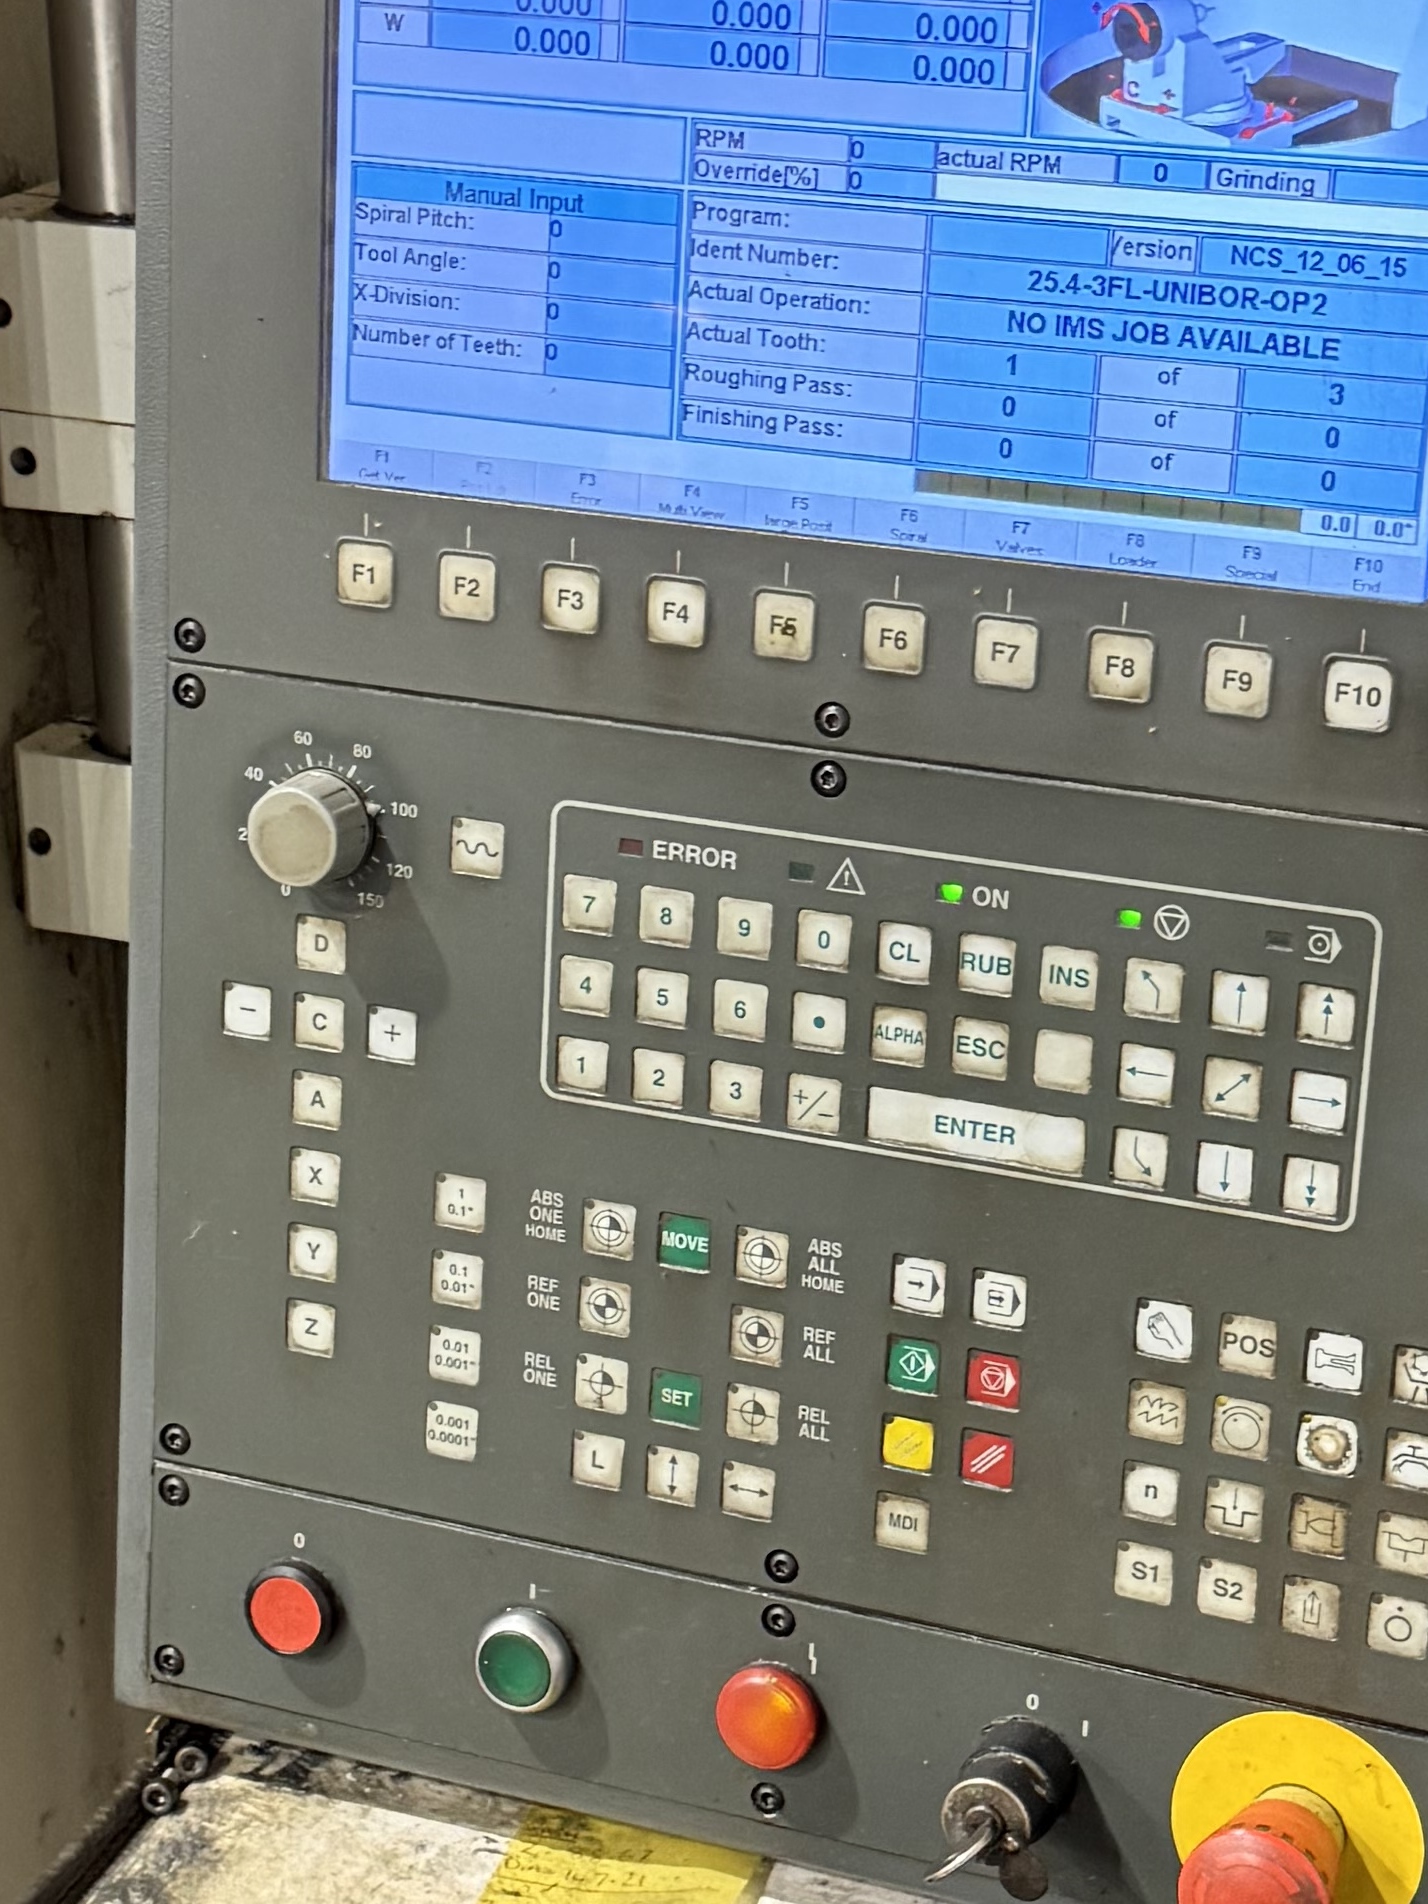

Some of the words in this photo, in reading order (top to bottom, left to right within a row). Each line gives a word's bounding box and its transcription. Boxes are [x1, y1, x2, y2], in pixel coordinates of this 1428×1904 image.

[712, 0, 792, 31] 0.000
[916, 12, 998, 45] 0.000
[384, 13, 406, 32] W
[514, 26, 591, 57] 0.000
[710, 40, 789, 71] 0.000
[913, 54, 995, 86] 0.000
[695, 128, 746, 150] RPM
[937, 149, 1004, 171] actual
[1009, 153, 1062, 176] RPM
[1154, 163, 1169, 184] 0
[1216, 167, 1317, 198] Grinding
[694, 159, 819, 191] Override[%]
[445, 180, 522, 209] Manual
[530, 188, 585, 215] Input
[354, 202, 412, 226] Spiral
[417, 207, 475, 231] Pitch:
[692, 200, 791, 229] Program:
[1230, 244, 1408, 282] NCS_12_06_15
[355, 242, 398, 265] Tool
[403, 248, 467, 273] Angle:
[690, 238, 744, 263] Ident
[747, 244, 840, 271] Number:
[352, 282, 460, 312] X-Division:
[688, 280, 754, 305] Actual
[760, 287, 871, 316] Operation:
[1007, 310, 1046, 334] NO
[1055, 314, 1104, 339] IMS
[1112, 320, 1170, 346] JOB
[1176, 326, 1342, 361] AVAILABLE
[352, 323, 431, 348] Number
[436, 330, 458, 350] of
[461, 333, 521, 358] Teeth:
[686, 321, 752, 346] Actual
[757, 327, 825, 353] Tooth:
[1158, 367, 1182, 387] of
[1328, 383, 1345, 406] 3
[685, 363, 787, 394] Roughing
[793, 373, 853, 398] Pass:
[1154, 409, 1178, 429] of
[682, 403, 778, 435] Finishing
[783, 414, 844, 439] Pass:
[1150, 451, 1175, 471] of
[1321, 514, 1351, 533] 0.0
[1012, 520, 1031, 535] F7
[1354, 557, 1384, 574] F10
[352, 563, 375, 585] F1
[454, 576, 480, 597] F2
[558, 589, 584, 611] F3
[662, 601, 689, 623] F4
[879, 628, 908, 650] F6
[990, 641, 1021, 664] F7
[1105, 656, 1136, 680] F8
[1222, 669, 1254, 693] F9
[1334, 684, 1383, 709] F10
[293, 730, 313, 746] 60
[353, 744, 372, 759] 80
[244, 766, 264, 781] 40
[390, 801, 419, 819] 100
[651, 839, 738, 870] ERROR
[386, 863, 414, 880] 120
[357, 892, 385, 909] 150
[972, 885, 1010, 911] ON
[314, 933, 329, 953] D
[582, 895, 597, 914] 7
[659, 906, 673, 926] 8
[737, 918, 752, 938] 9
[888, 940, 921, 964] CL
[960, 951, 1012, 977] RUB
[1048, 963, 1091, 989] INS
[312, 1013, 328, 1031] C
[578, 975, 593, 995] 4
[655, 988, 670, 1008] 5
[733, 1000, 747, 1020] 6
[874, 1023, 925, 1048] ALPHA
[956, 1034, 1006, 1061] ESC
[310, 1090, 326, 1109] A
[652, 1067, 666, 1088] 2
[729, 1080, 743, 1101] 3
[934, 1115, 1017, 1146] ENTER
[308, 1165, 323, 1186] X
[530, 1188, 565, 1208] ABS
[529, 1206, 564, 1226] ONE
[525, 1224, 567, 1244] HOME
[661, 1229, 710, 1254] MOVE
[306, 1241, 321, 1261] Y
[807, 1238, 843, 1259] ABS
[807, 1256, 840, 1277] ALL
[527, 1274, 560, 1293] REF
[801, 1274, 845, 1294] HOME
[526, 1292, 561, 1311] ONE
[304, 1317, 319, 1336] Z
[803, 1326, 836, 1346] REF
[442, 1339, 470, 1354] 0.01
[803, 1344, 836, 1364] ALL
[1222, 1332, 1276, 1359] POS
[524, 1350, 556, 1371] REL
[523, 1368, 558, 1388] ONE
[660, 1387, 693, 1408] SET
[435, 1414, 470, 1431] 0.001
[798, 1404, 830, 1425] REL
[798, 1423, 830, 1443] ALL
[590, 1449, 605, 1470] L
[888, 1511, 919, 1533] MDI
[1130, 1561, 1160, 1585] S1
[1213, 1578, 1243, 1602] S2
